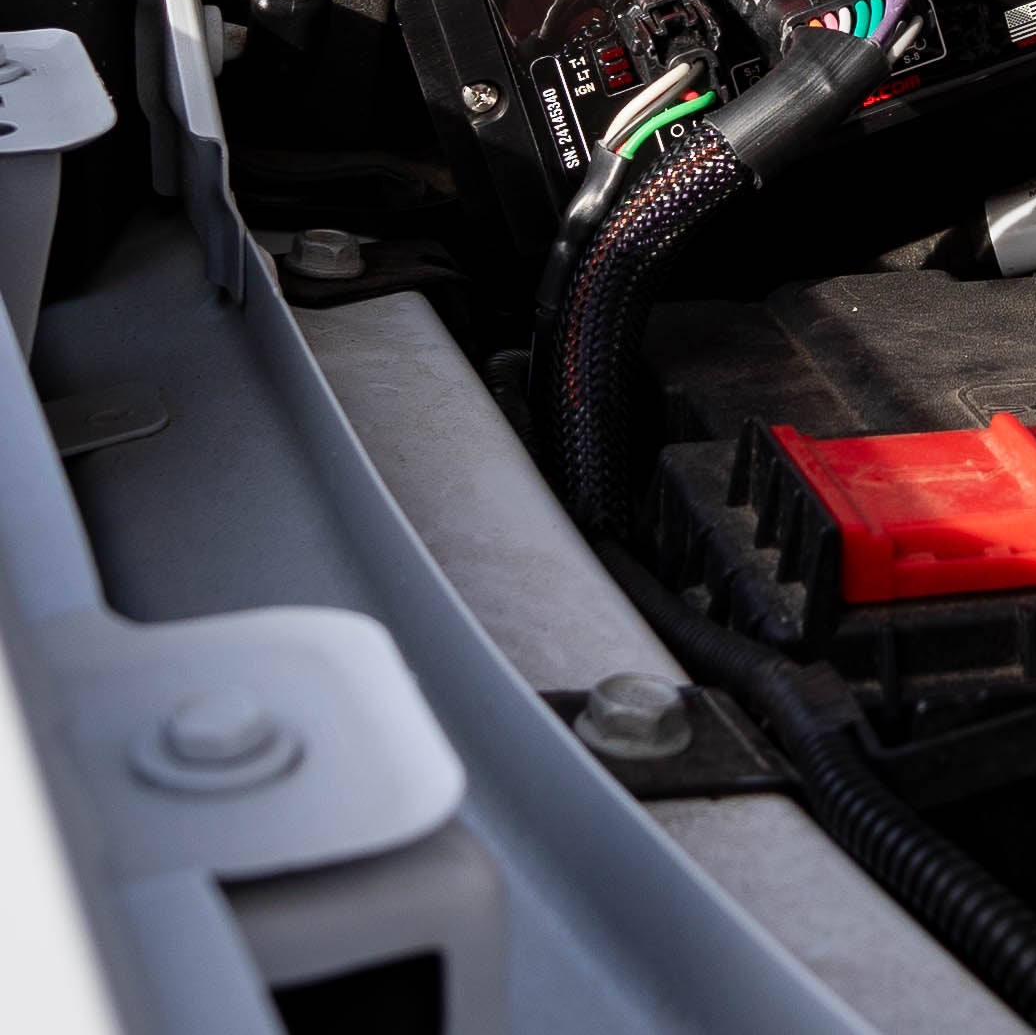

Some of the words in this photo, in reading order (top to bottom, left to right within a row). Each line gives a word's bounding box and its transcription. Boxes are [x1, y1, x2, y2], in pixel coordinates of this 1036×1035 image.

[568, 56, 587, 69] T-1
[576, 68, 591, 82] LT
[573, 81, 596, 97] IGN
[542, 88, 573, 145] 24145340
[562, 146, 580, 169] SN:
